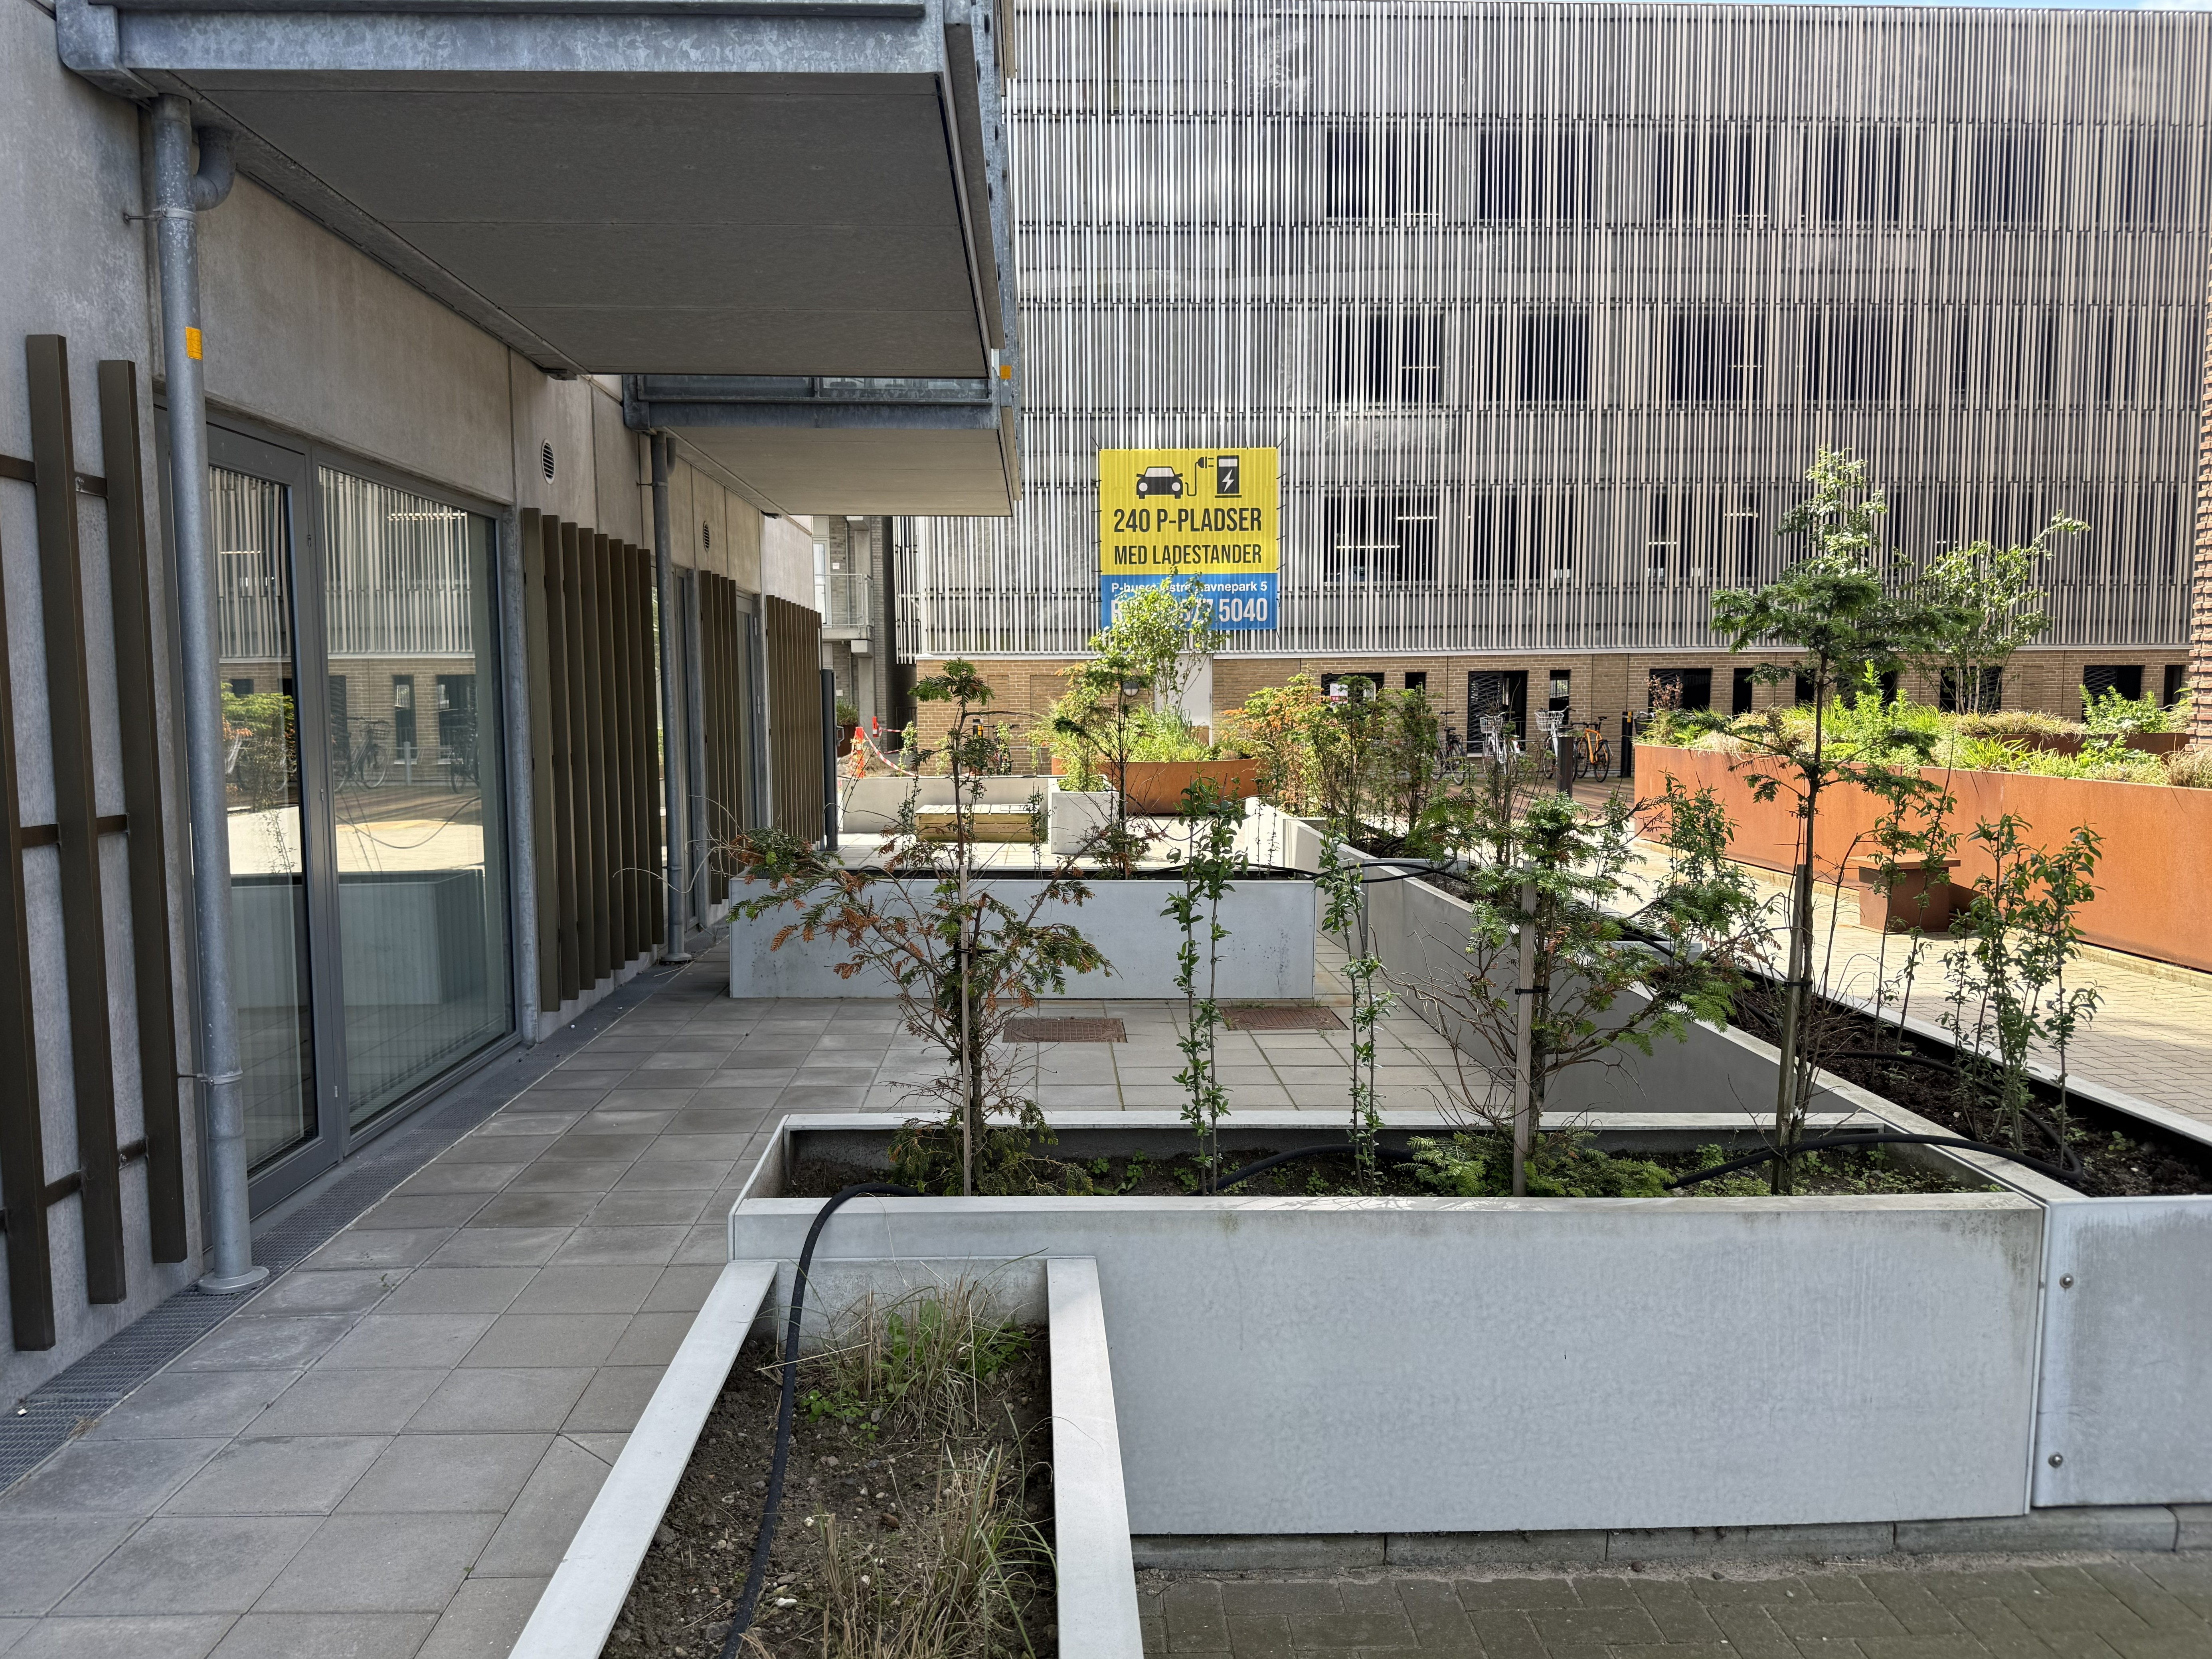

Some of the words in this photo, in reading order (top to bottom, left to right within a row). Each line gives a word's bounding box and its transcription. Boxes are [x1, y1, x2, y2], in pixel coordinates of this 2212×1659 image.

[1114, 508, 1150, 532] 240
[1157, 508, 1261, 532] P-PLADSER
[1115, 545, 1147, 565] MED
[1153, 544, 1261, 564] LADESTANDER
[1160, 582, 1190, 593] stre
[1195, 581, 1257, 594] avnepark
[1260, 581, 1267, 591] 5
[1219, 598, 1267, 622] 5040
